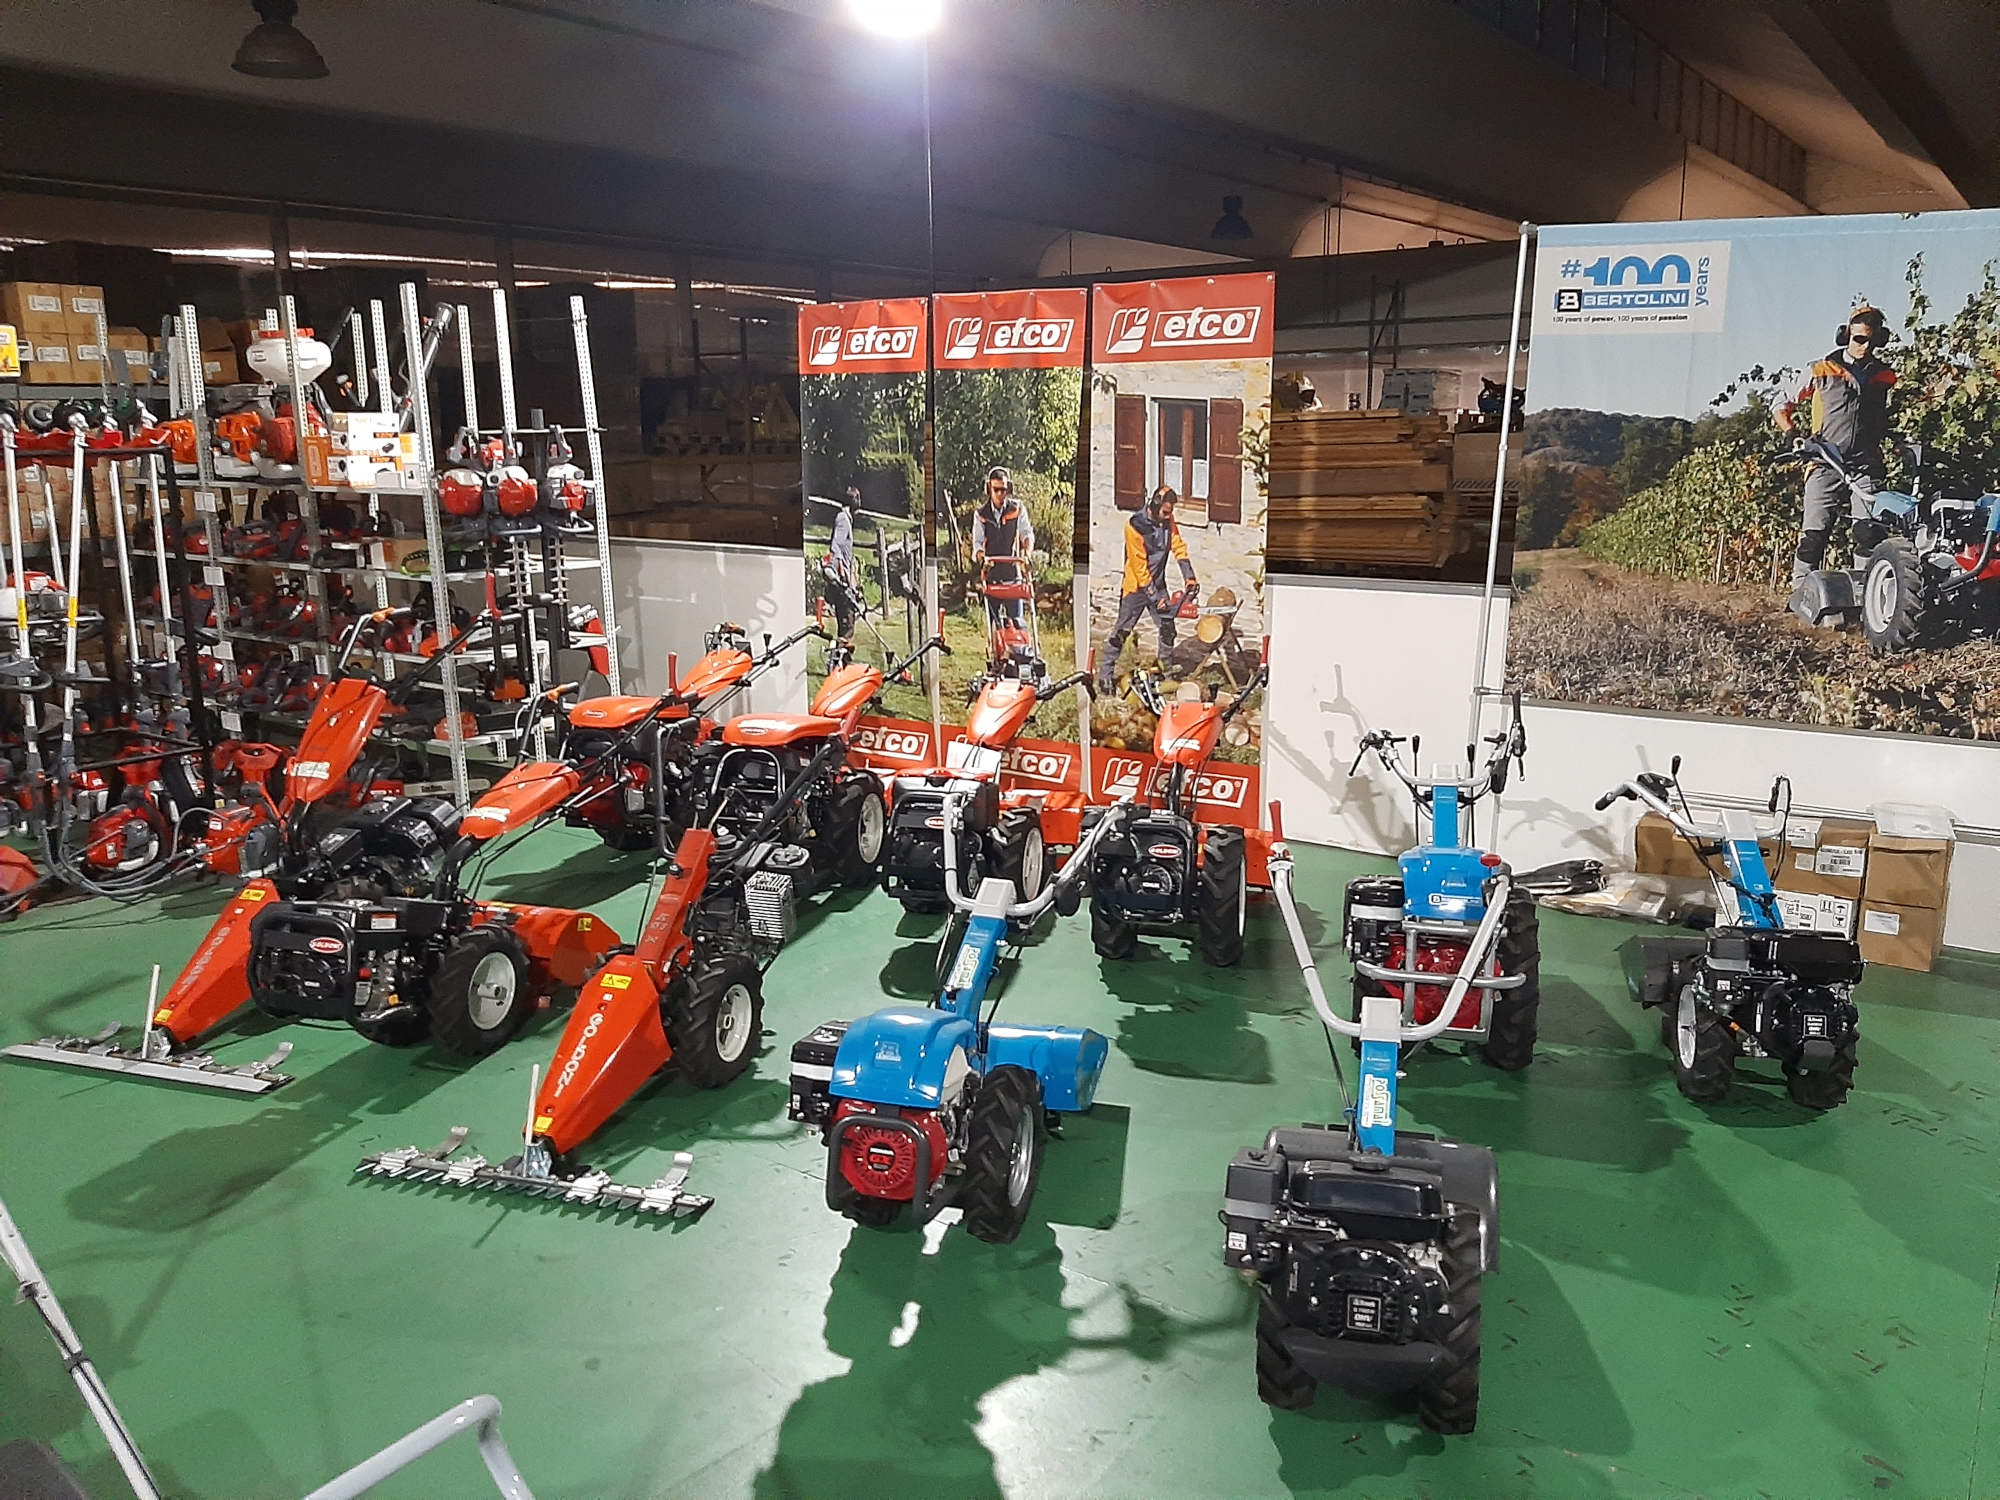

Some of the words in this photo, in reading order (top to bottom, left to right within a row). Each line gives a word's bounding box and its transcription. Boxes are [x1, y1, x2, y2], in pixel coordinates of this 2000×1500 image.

[1695, 256, 1710, 307] years
[1583, 292, 1687, 307] BERTOLINI
[994, 317, 1061, 347] efco
[1163, 306, 1246, 339] efco
[850, 325, 907, 353] efco
[860, 727, 919, 754] efco
[553, 1013, 604, 1098] GOLDONI
